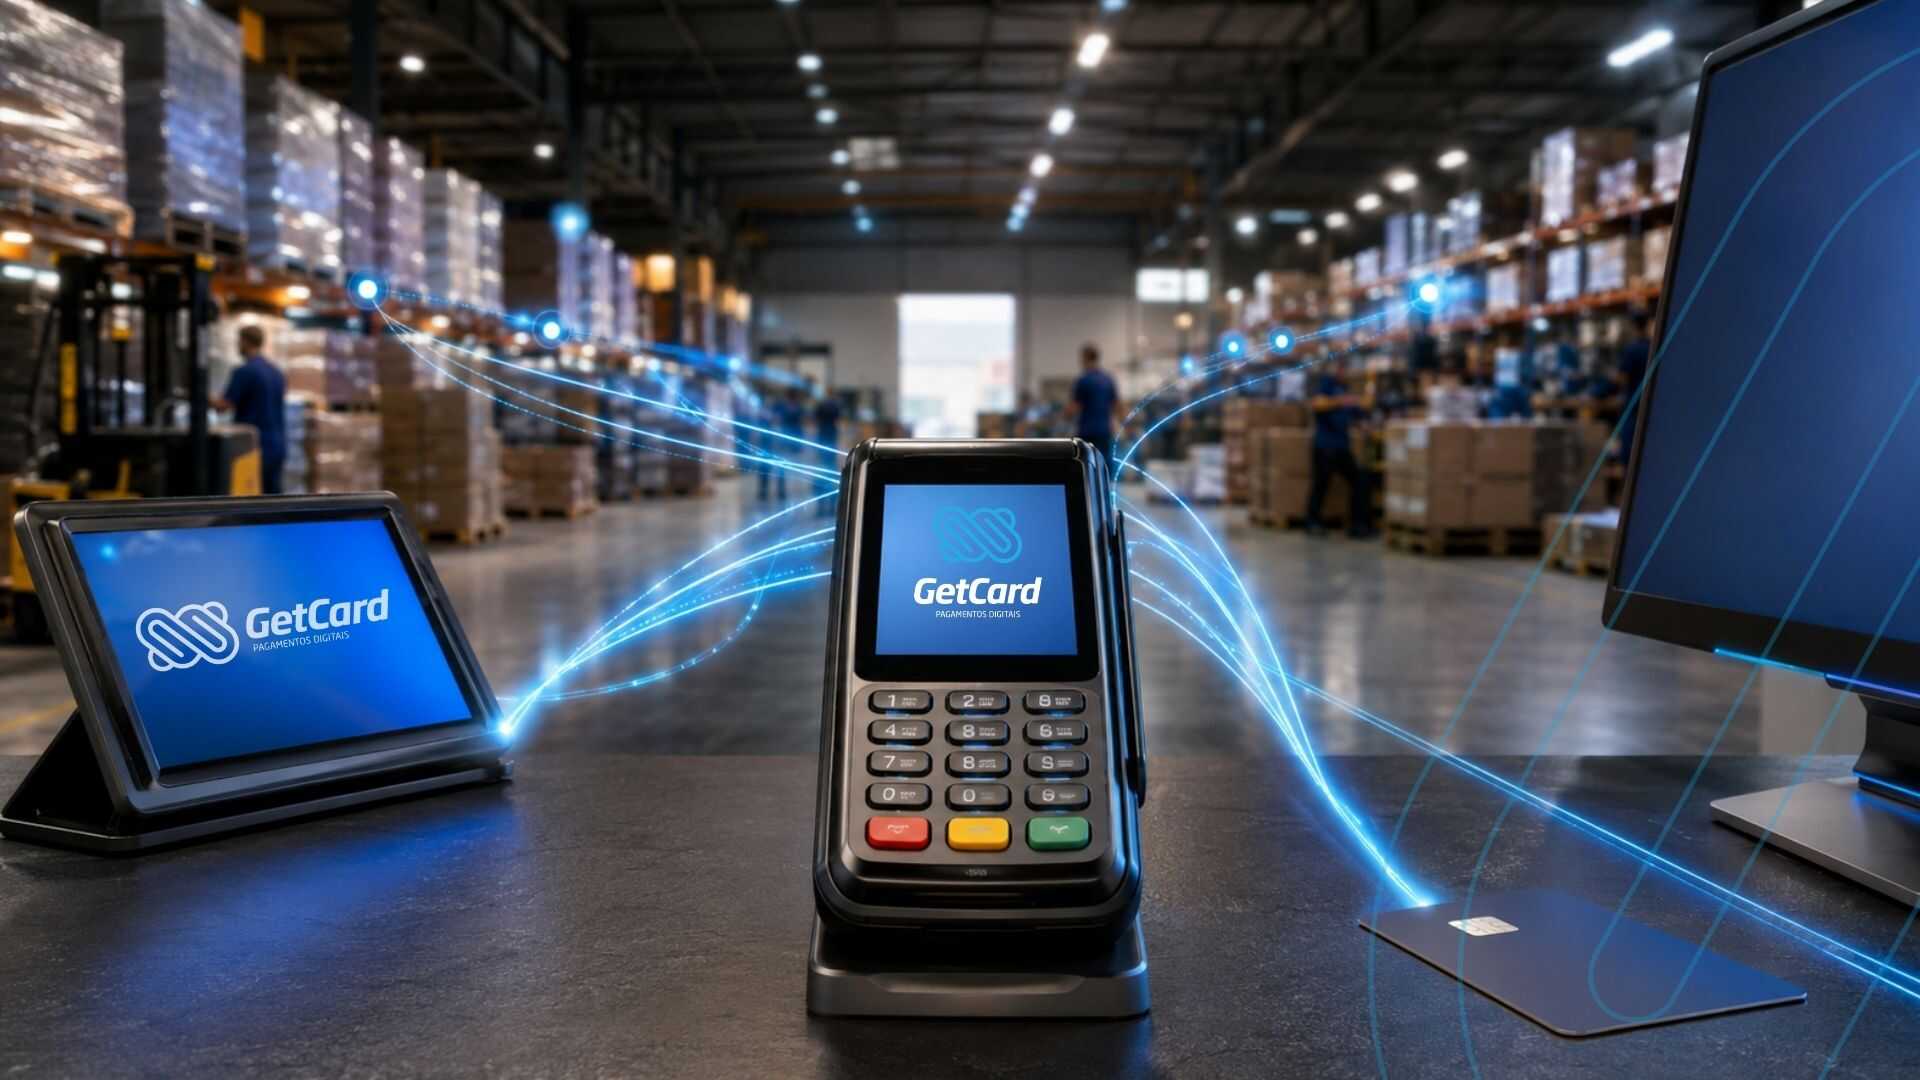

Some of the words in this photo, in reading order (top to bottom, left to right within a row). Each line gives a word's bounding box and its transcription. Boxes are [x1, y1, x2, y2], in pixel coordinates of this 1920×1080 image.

[913, 576, 1042, 605] GetCard
[245, 588, 389, 639] GetCard
[935, 610, 986, 618] PAGAMENTOS
[988, 610, 1021, 618] DIGITAIS
[252, 635, 311, 652] PAGAMENTOS
[313, 630, 350, 644] DIGITAIS
[887, 694, 896, 707] 1
[963, 694, 975, 707] 2
[885, 724, 896, 736] 4
[883, 755, 896, 769] 7
[963, 755, 975, 770] 8
